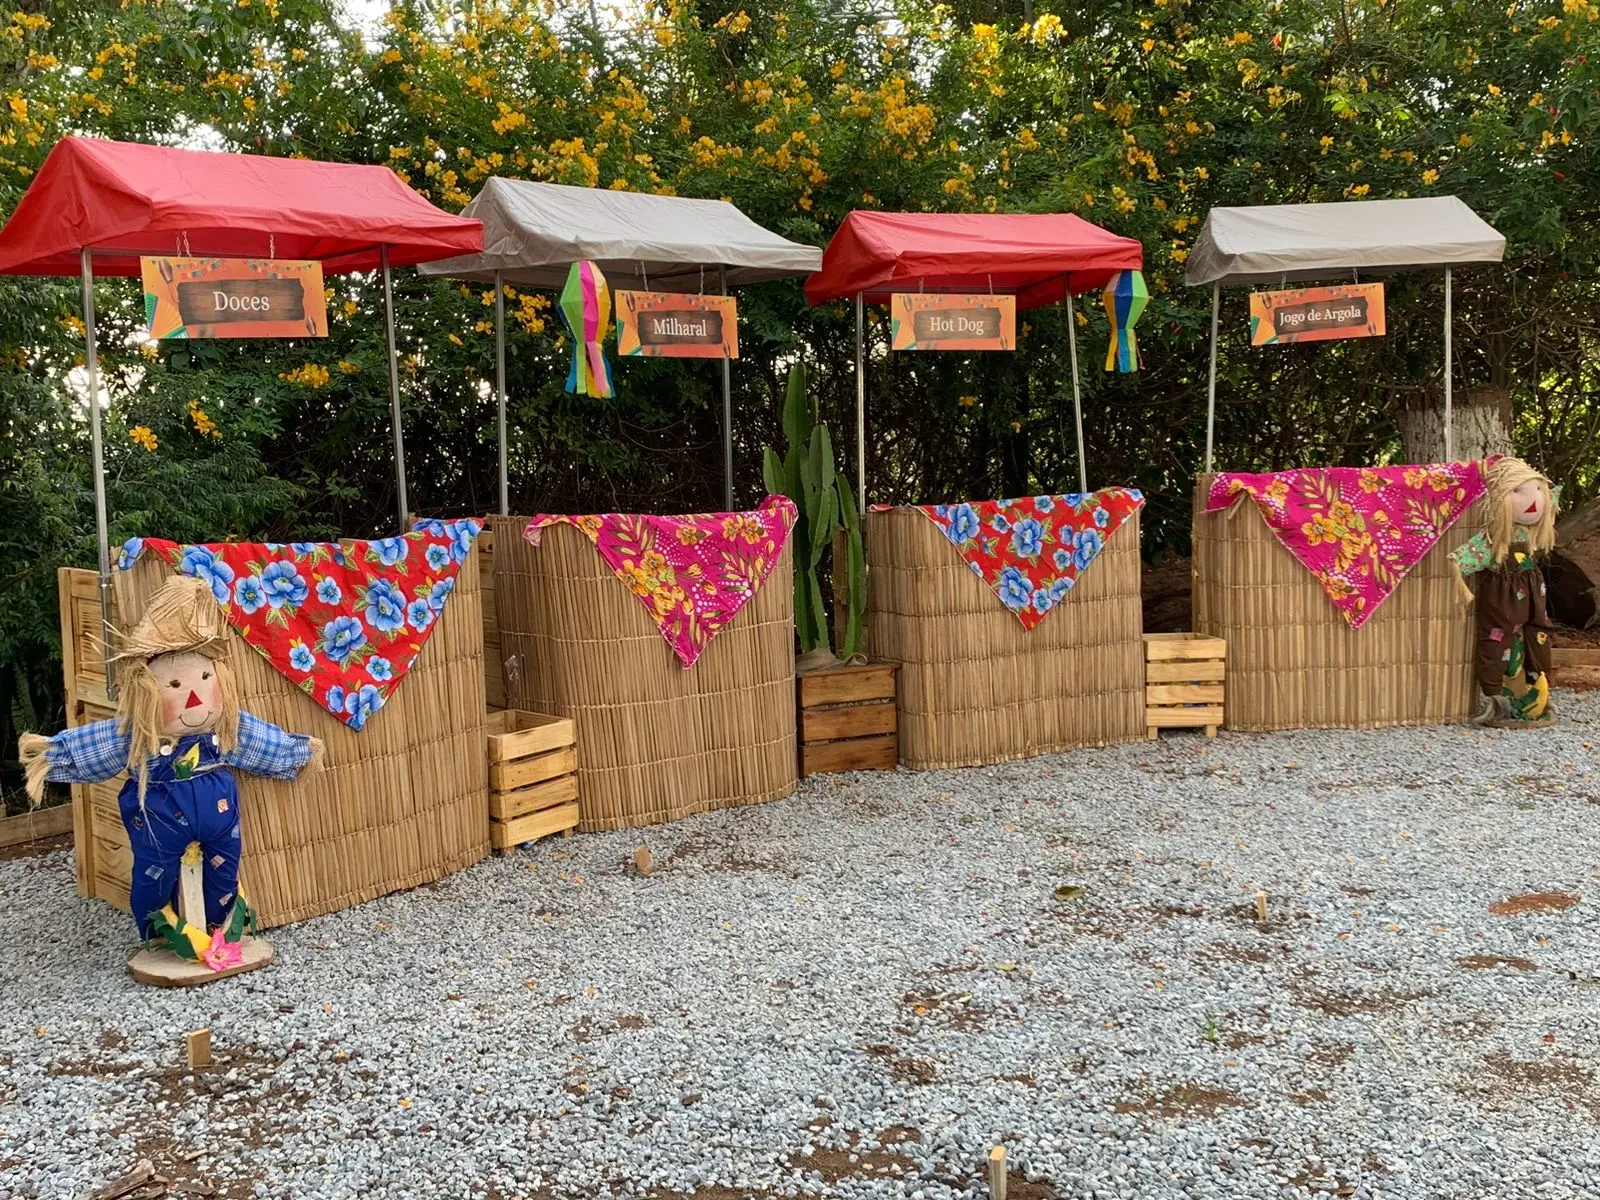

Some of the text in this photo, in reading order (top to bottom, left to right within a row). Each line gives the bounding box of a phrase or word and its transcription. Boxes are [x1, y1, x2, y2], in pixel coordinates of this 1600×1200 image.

[212, 291, 271, 311] Doces
[1279, 305, 1362, 326] Jogo de Argola
[653, 318, 707, 337] Milharal
[930, 317, 984, 336] Hot Dog
